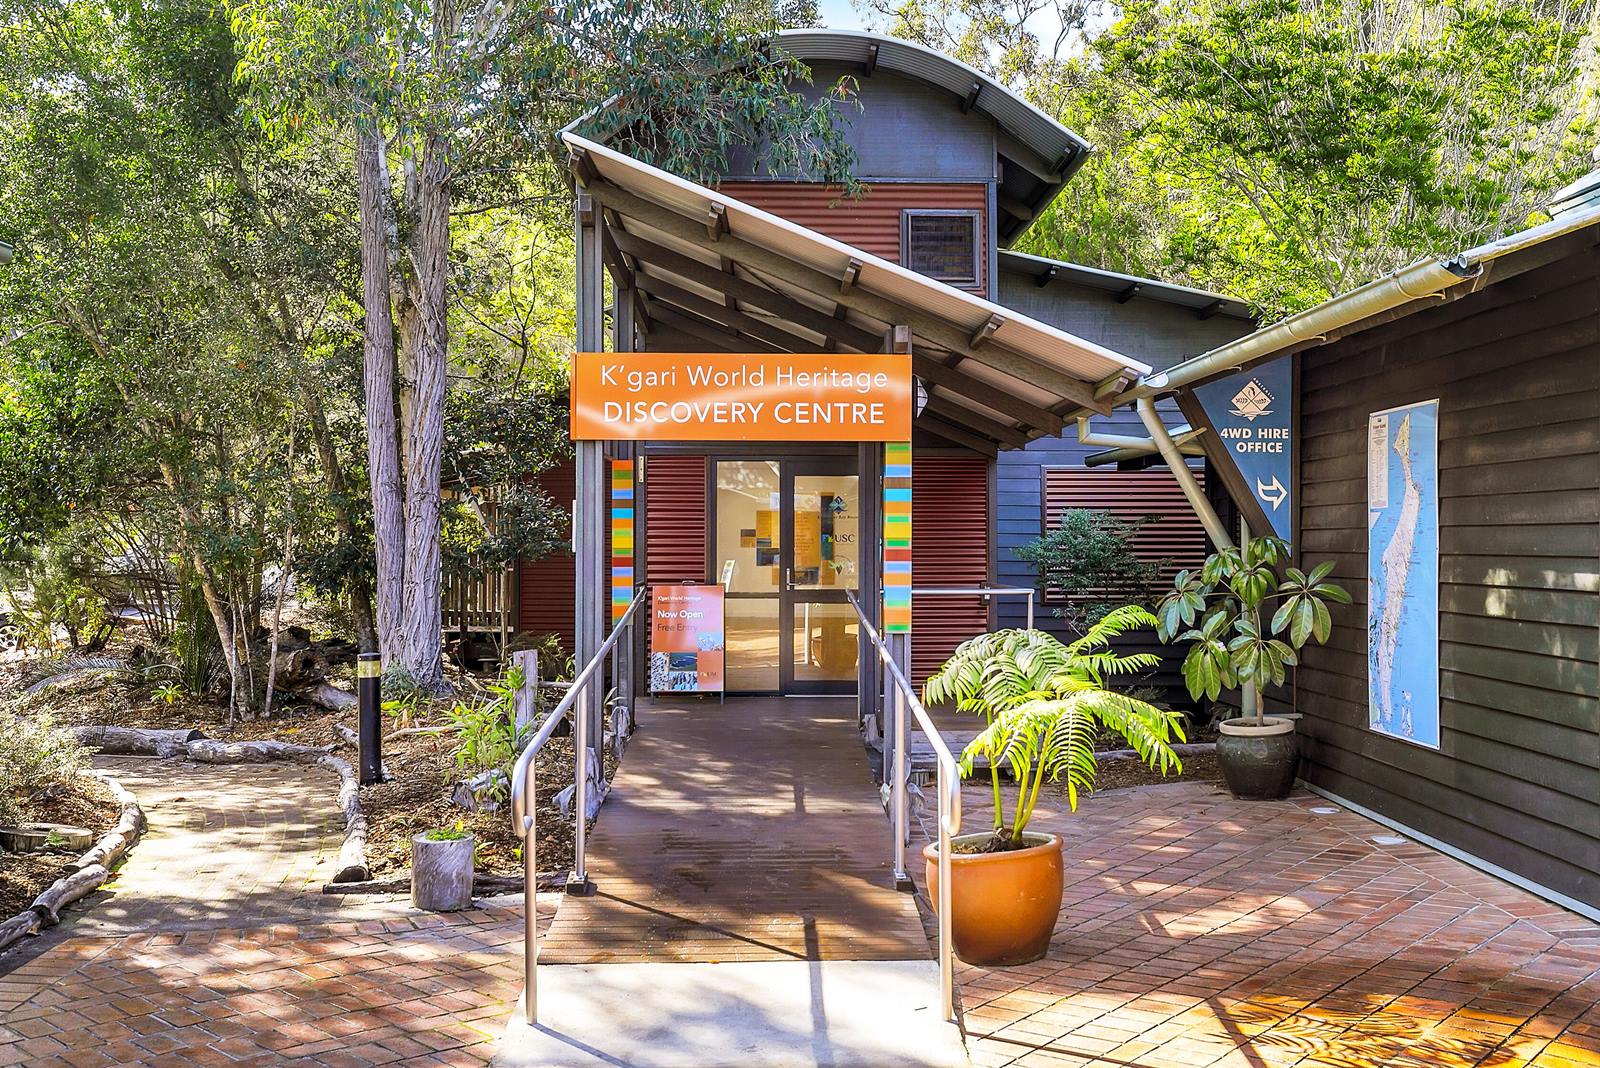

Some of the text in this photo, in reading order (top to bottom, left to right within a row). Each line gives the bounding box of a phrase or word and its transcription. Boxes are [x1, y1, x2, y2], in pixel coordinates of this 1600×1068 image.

[687, 365, 765, 387] World
[776, 366, 888, 394] Heritage
[603, 401, 885, 424] DISCOVERY CENTRE
[1220, 428, 1289, 439] 4WD HIRE
[1236, 442, 1283, 453] OFFICE
[834, 533, 855, 543] USC
[657, 609, 704, 620] Now Open
[657, 623, 698, 632] Free Entry
